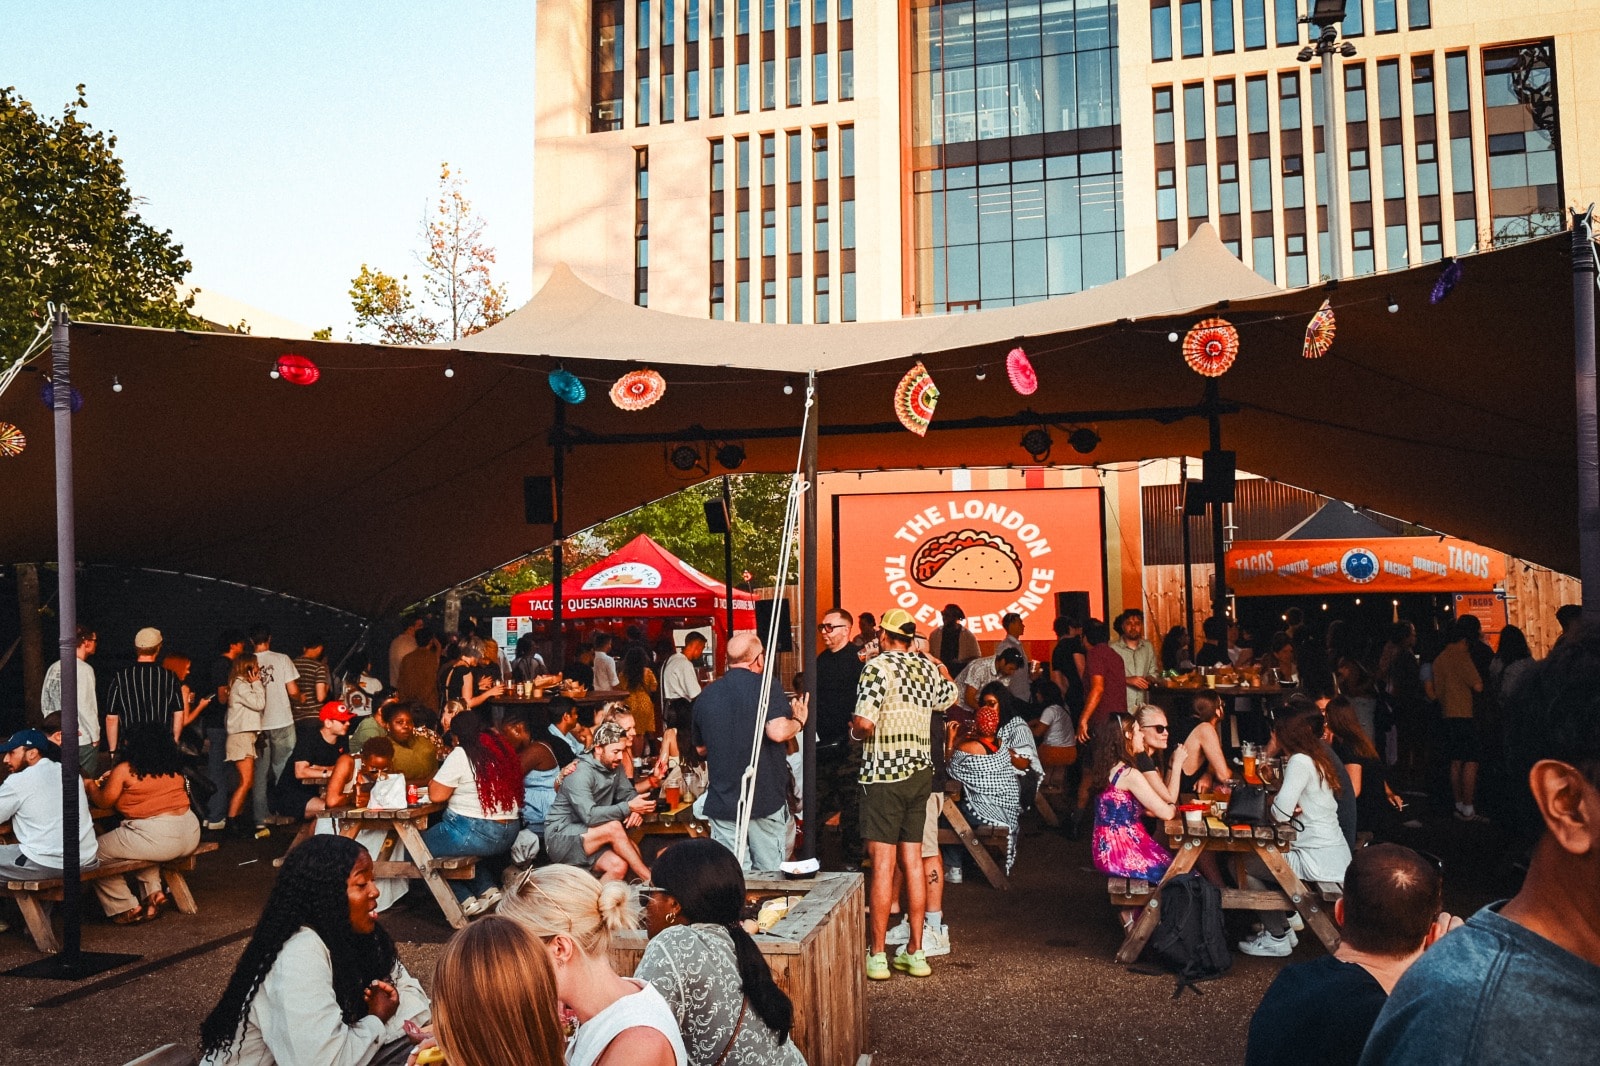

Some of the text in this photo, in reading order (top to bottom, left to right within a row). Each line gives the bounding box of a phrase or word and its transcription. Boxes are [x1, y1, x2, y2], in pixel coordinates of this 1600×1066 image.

[894, 499, 1052, 558] THE LONDON
[1235, 550, 1274, 579] TACOS
[1384, 560, 1411, 579] NACHOS
[1412, 556, 1447, 577] BURRITOS
[1448, 545, 1489, 579] TACOS
[884, 555, 919, 608] TACO
[528, 597, 697, 612] TACO QUESABIRRIAS SNACKS
[1468, 598, 1493, 607] TACOS
